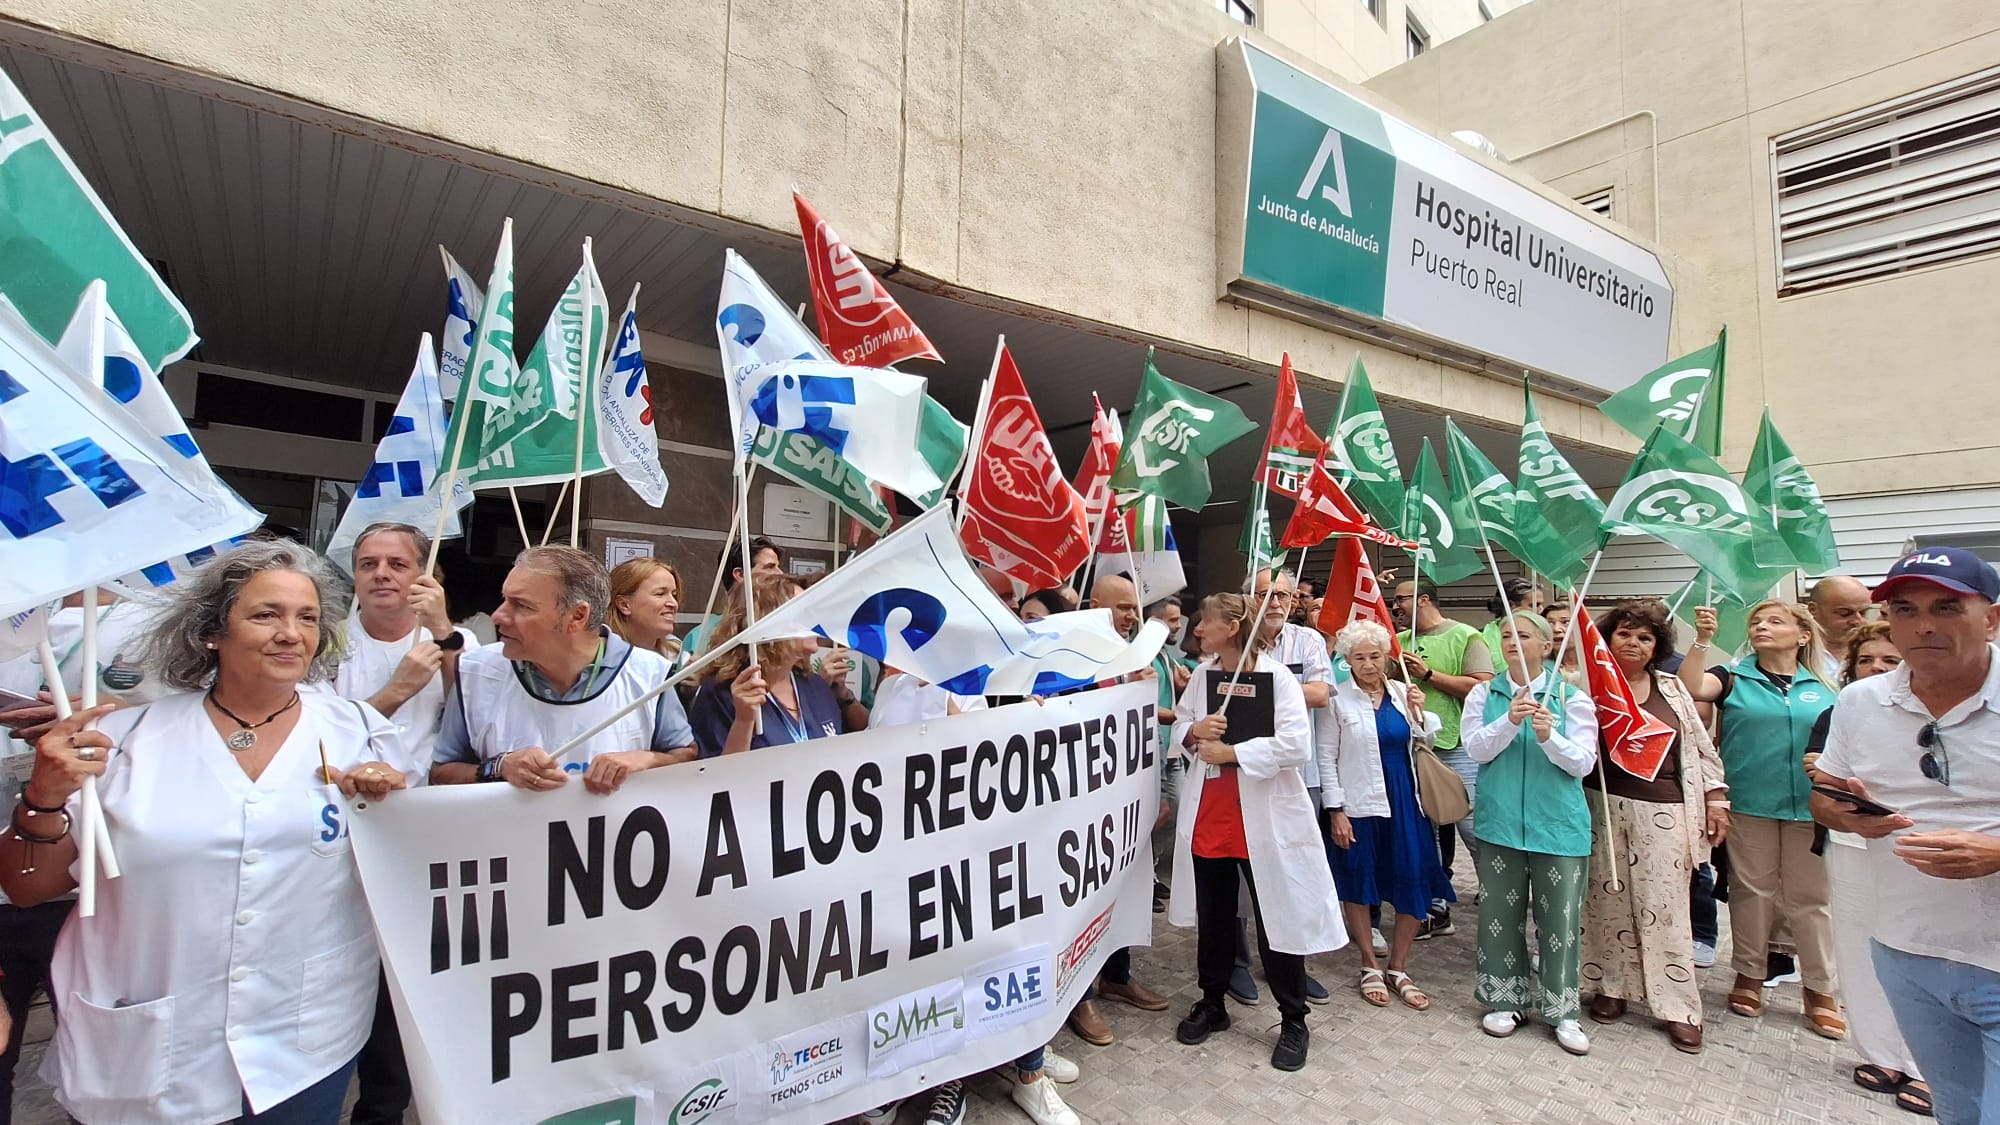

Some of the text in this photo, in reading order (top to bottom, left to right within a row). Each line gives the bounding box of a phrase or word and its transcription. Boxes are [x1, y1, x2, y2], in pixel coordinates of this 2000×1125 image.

[1257, 194, 1379, 254] Junta de Andalucía
[1415, 181, 1654, 318] Hospital Universitario
[1411, 238, 1524, 308] Puerto Real
[609, 394, 650, 455] ANDALUZA DE
[1519, 439, 1601, 501] CSIF
[1903, 553, 1951, 568] FILA
[547, 806, 670, 927] NO
[696, 791, 748, 897] A
[770, 762, 883, 879] LOS
[904, 713, 1117, 840] RECORTES
[1126, 704, 1154, 776] DE
[491, 798, 1140, 1083] PERSONAL EN EL SAS !!!
[793, 1037, 843, 1066] TECCEL
[873, 996, 957, 1048] SMA
[681, 1088, 729, 1117] CSIF
[770, 1077, 811, 1105] TECNOS
[816, 1065, 844, 1086] CEAN
